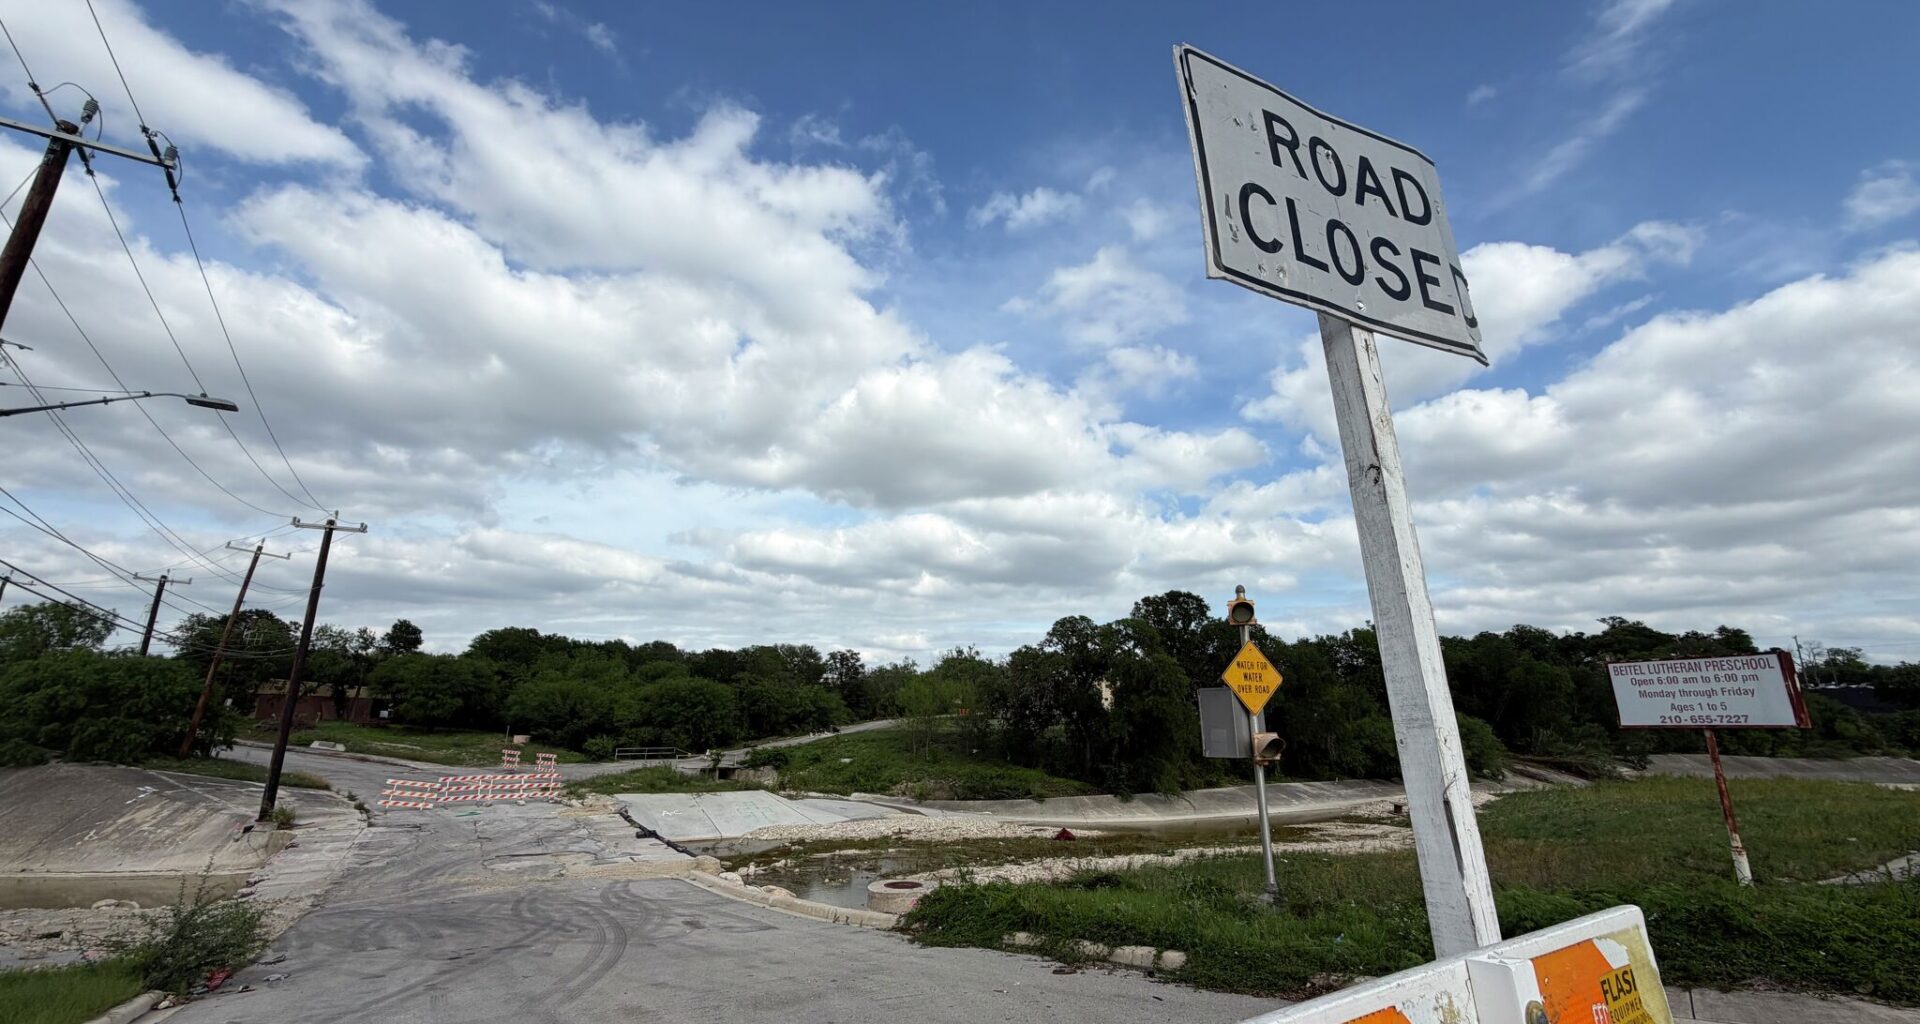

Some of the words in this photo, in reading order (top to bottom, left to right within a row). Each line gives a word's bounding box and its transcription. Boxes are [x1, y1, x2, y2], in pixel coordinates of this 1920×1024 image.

[1261, 108, 1432, 227] ROAD
[1238, 182, 1478, 329] CLOSED
[1236, 660, 1255, 670] WATCH
[1256, 661, 1268, 670] FOR
[1612, 664, 1646, 676] BEITEL
[1647, 661, 1703, 675] LUTHERAN
[1704, 657, 1775, 672] PRESCHOOL
[1243, 672, 1263, 682] WATER
[1630, 677, 1655, 687] Open
[1657, 676, 1679, 685] 6:00
[1682, 676, 1699, 684] am
[1700, 675, 1711, 684] to
[1713, 673, 1738, 683] 6:00
[1741, 673, 1759, 684] pm
[1237, 684, 1252, 694] OVER
[1255, 684, 1270, 694] ROAD
[1638, 689, 1676, 699] Monday
[1679, 688, 1718, 699] through
[1720, 687, 1755, 698] Friday
[1670, 702, 1695, 713] Ages
[1697, 702, 1703, 711] 1
[1707, 702, 1718, 711] to
[1720, 701, 1728, 711] 5
